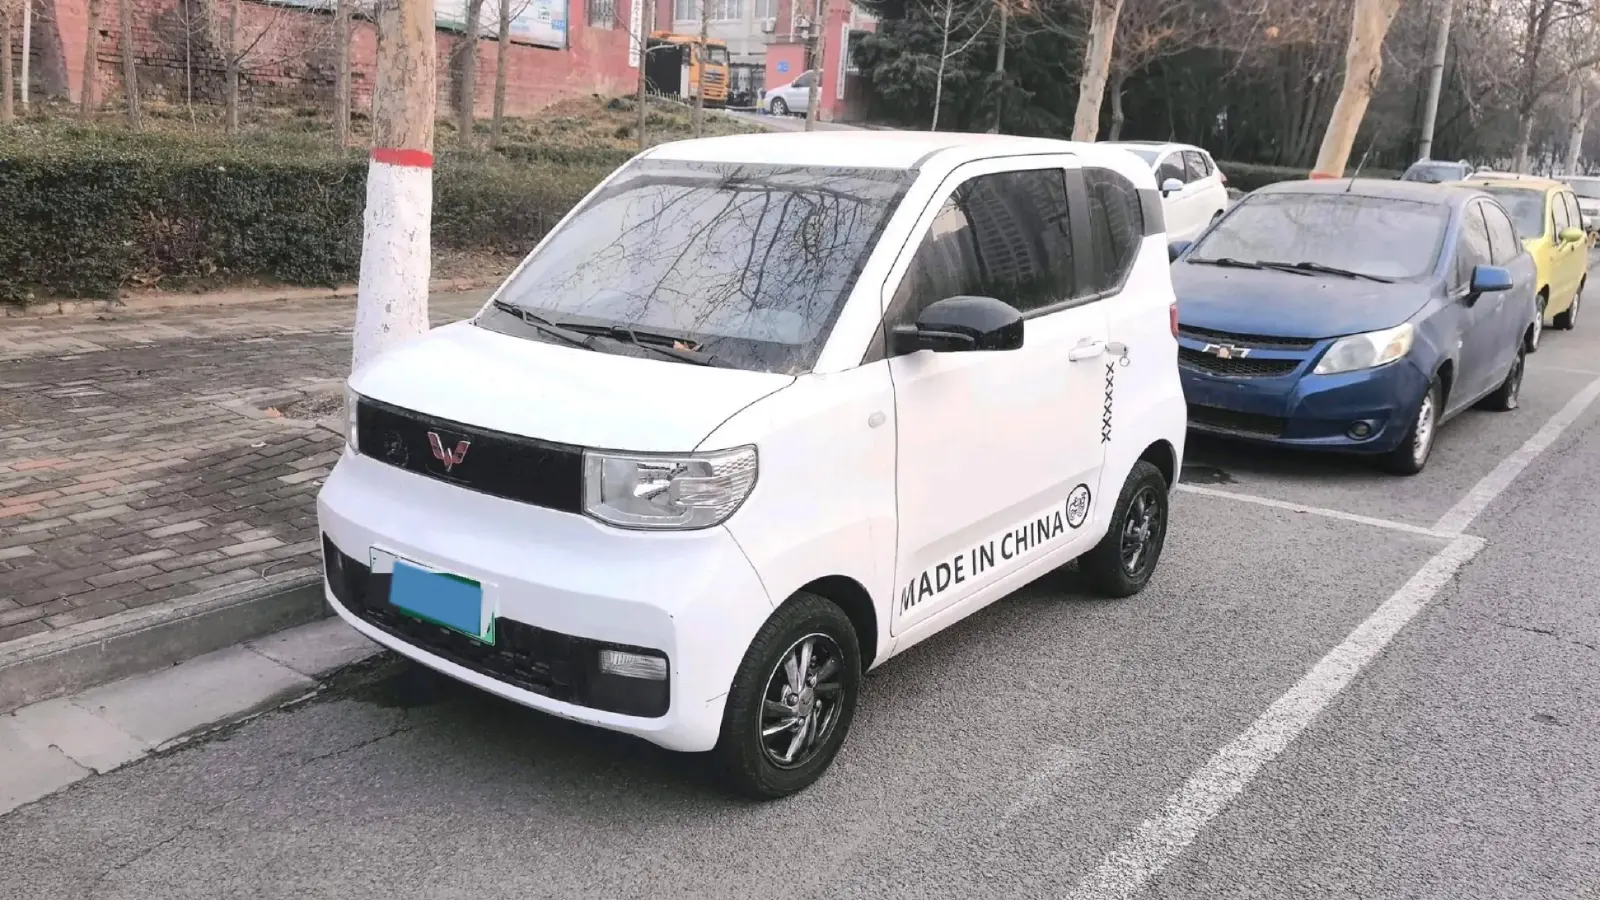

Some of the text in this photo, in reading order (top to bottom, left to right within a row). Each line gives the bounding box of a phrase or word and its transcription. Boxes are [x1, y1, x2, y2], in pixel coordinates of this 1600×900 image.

[899, 511, 1064, 617] MADE IN CHINA
